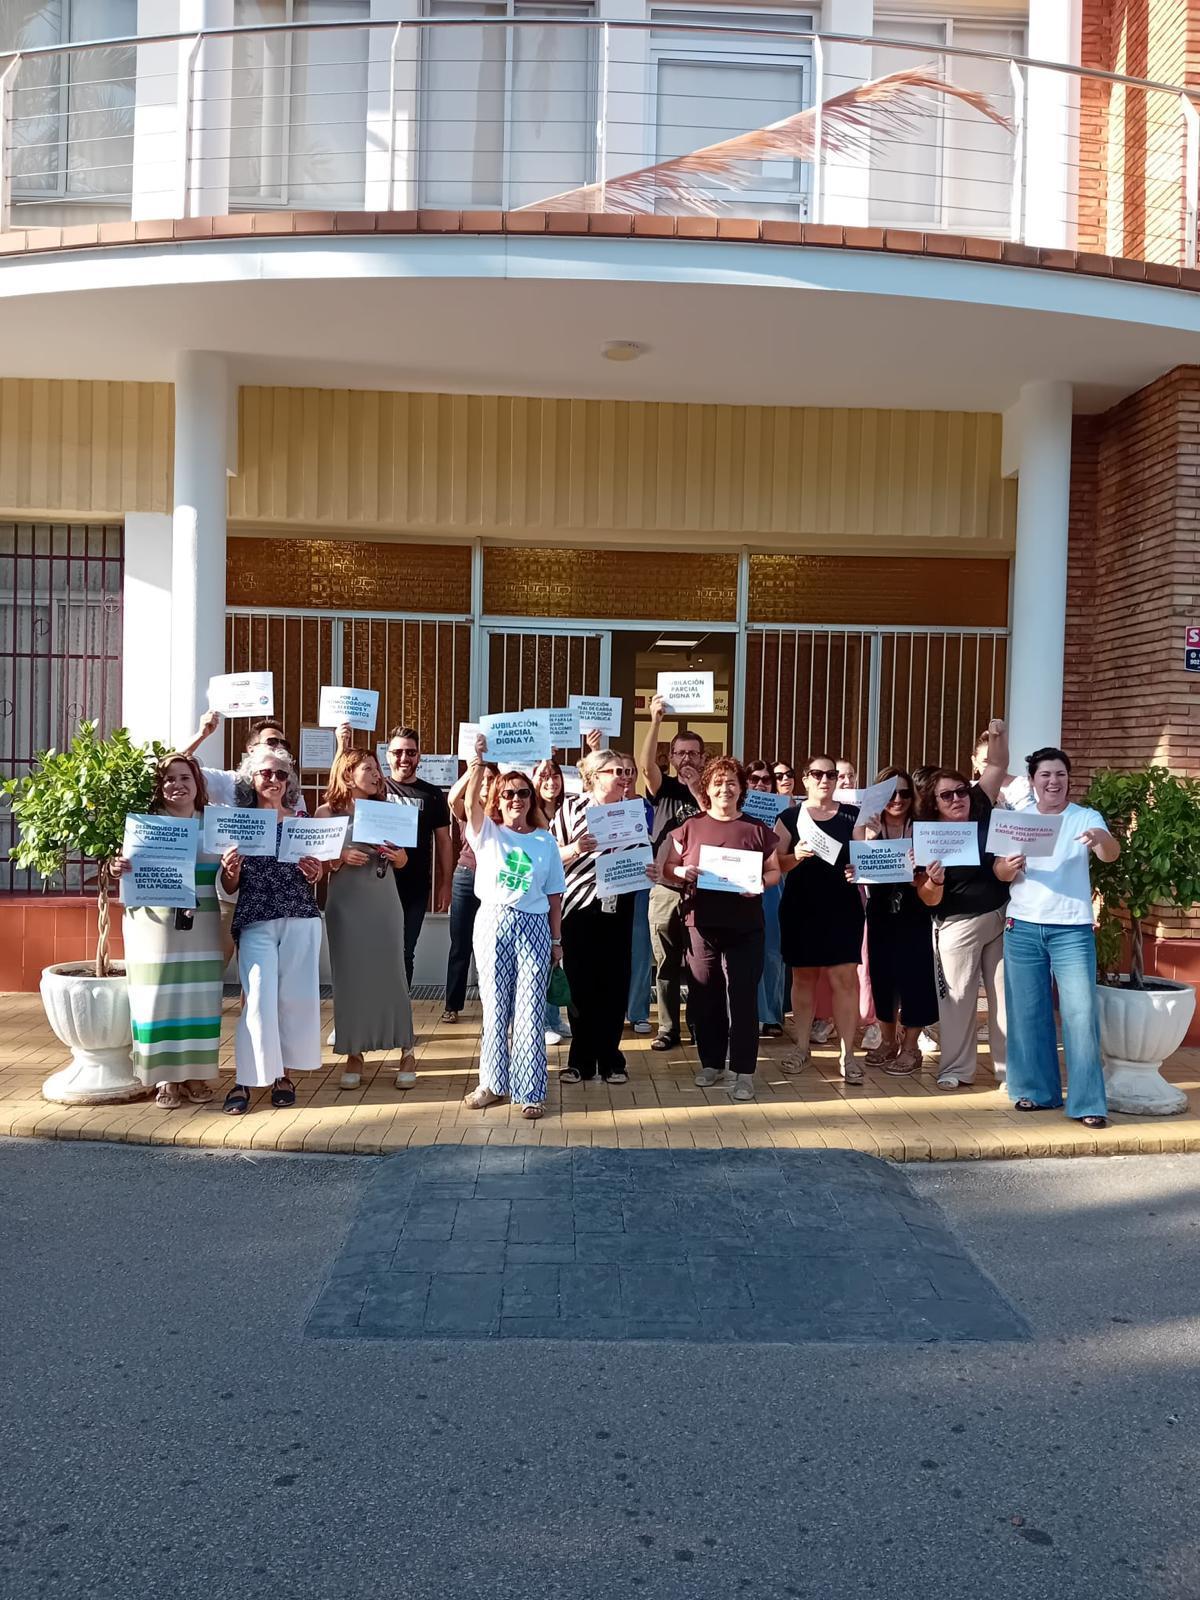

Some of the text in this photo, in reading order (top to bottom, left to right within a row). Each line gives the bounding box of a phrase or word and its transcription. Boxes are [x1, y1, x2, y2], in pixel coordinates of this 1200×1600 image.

[490, 720, 538, 730] JUBILACIÓN
[135, 829, 180, 837] ACTUALIZACIÓN
[614, 865, 646, 876] CALENDARIO
